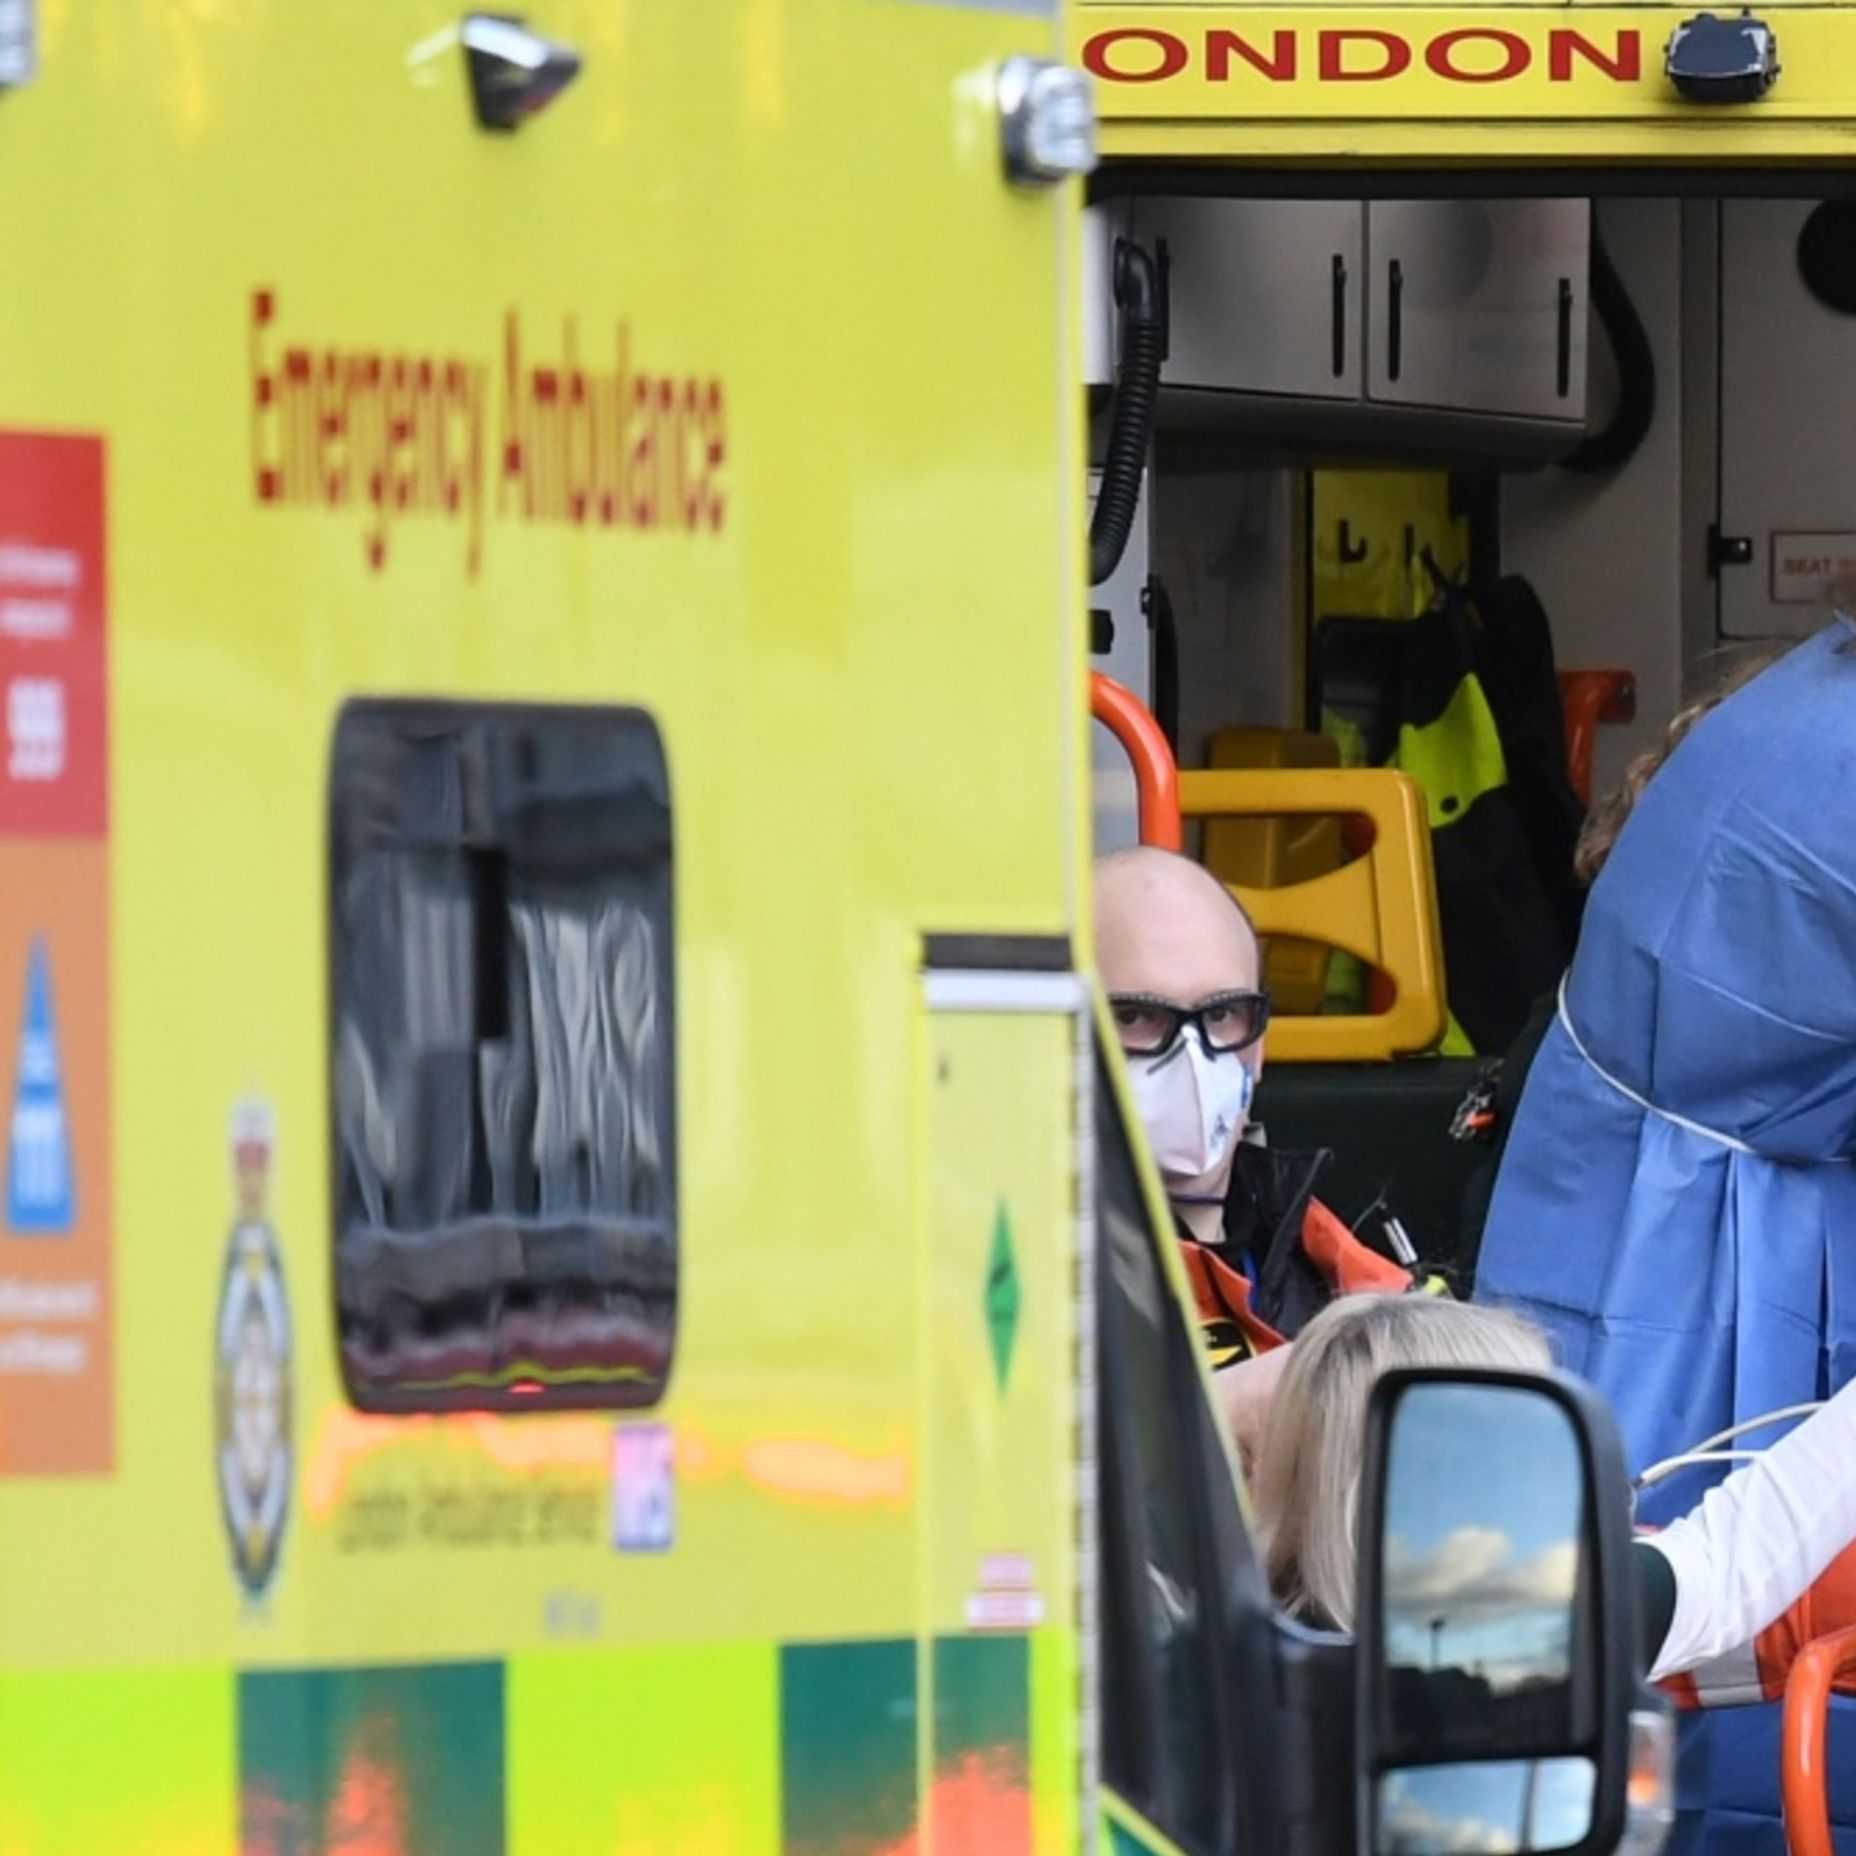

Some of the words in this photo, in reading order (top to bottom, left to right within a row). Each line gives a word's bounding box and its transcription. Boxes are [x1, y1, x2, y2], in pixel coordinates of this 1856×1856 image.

[1081, 27, 1641, 82] ONDON
[252, 288, 488, 585] Emergency
[496, 304, 727, 532] Ambulance
